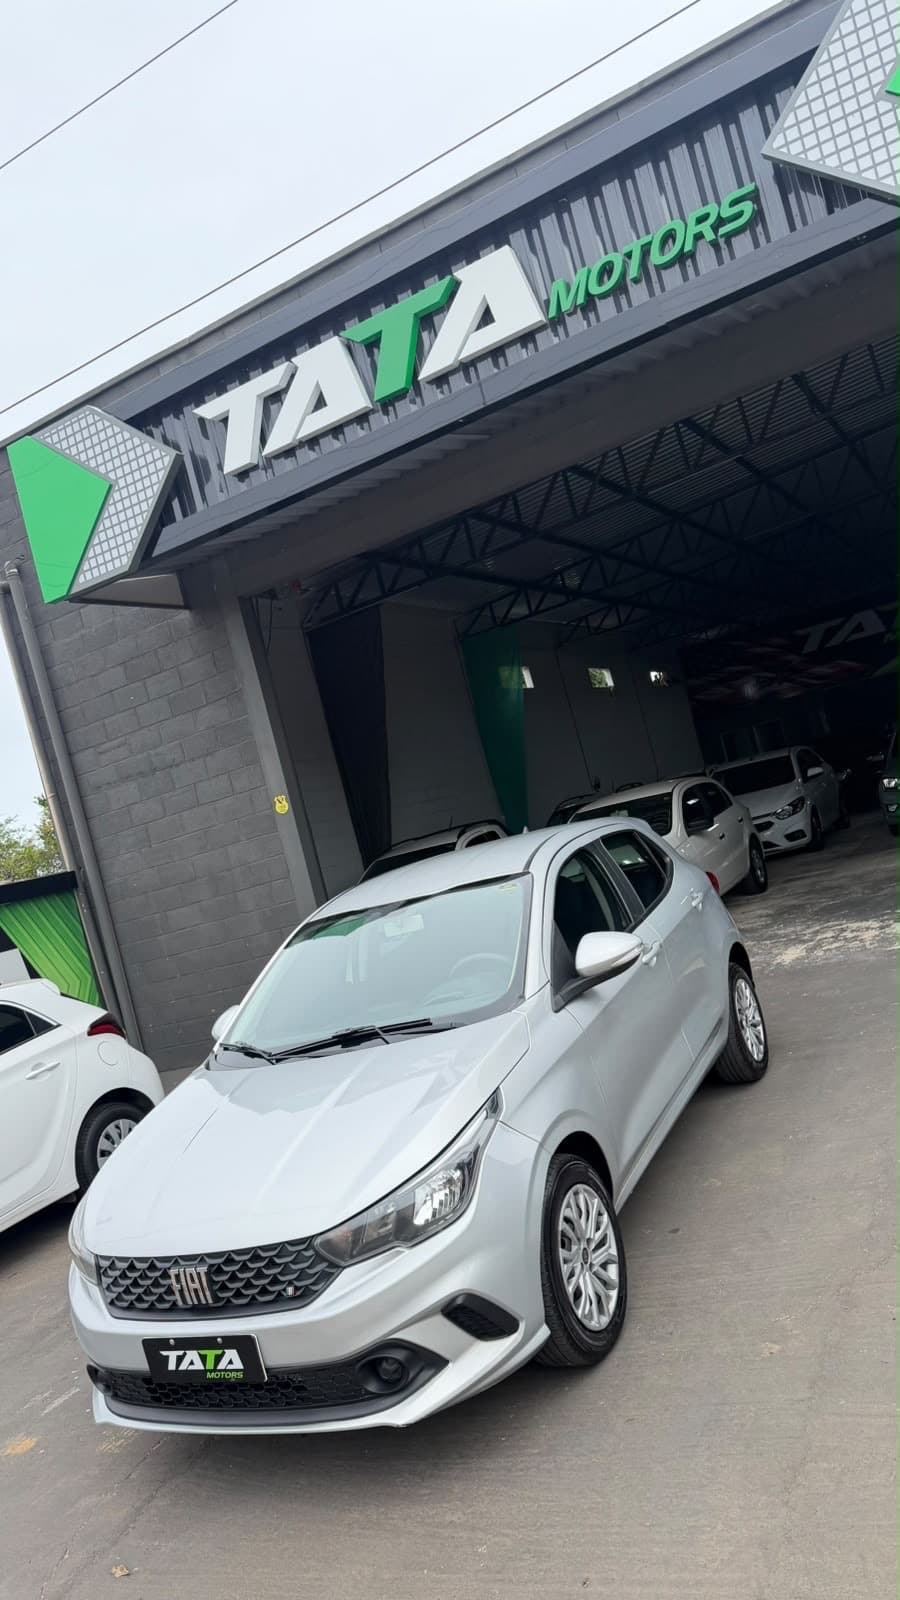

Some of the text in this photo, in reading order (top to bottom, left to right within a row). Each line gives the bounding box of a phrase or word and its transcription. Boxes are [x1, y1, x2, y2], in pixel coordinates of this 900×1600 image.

[193, 183, 757, 476] TATA MOTORS
[170, 1267, 213, 1305] FIAT
[160, 1349, 244, 1370] TATA
[206, 1371, 244, 1379] MOTORS
